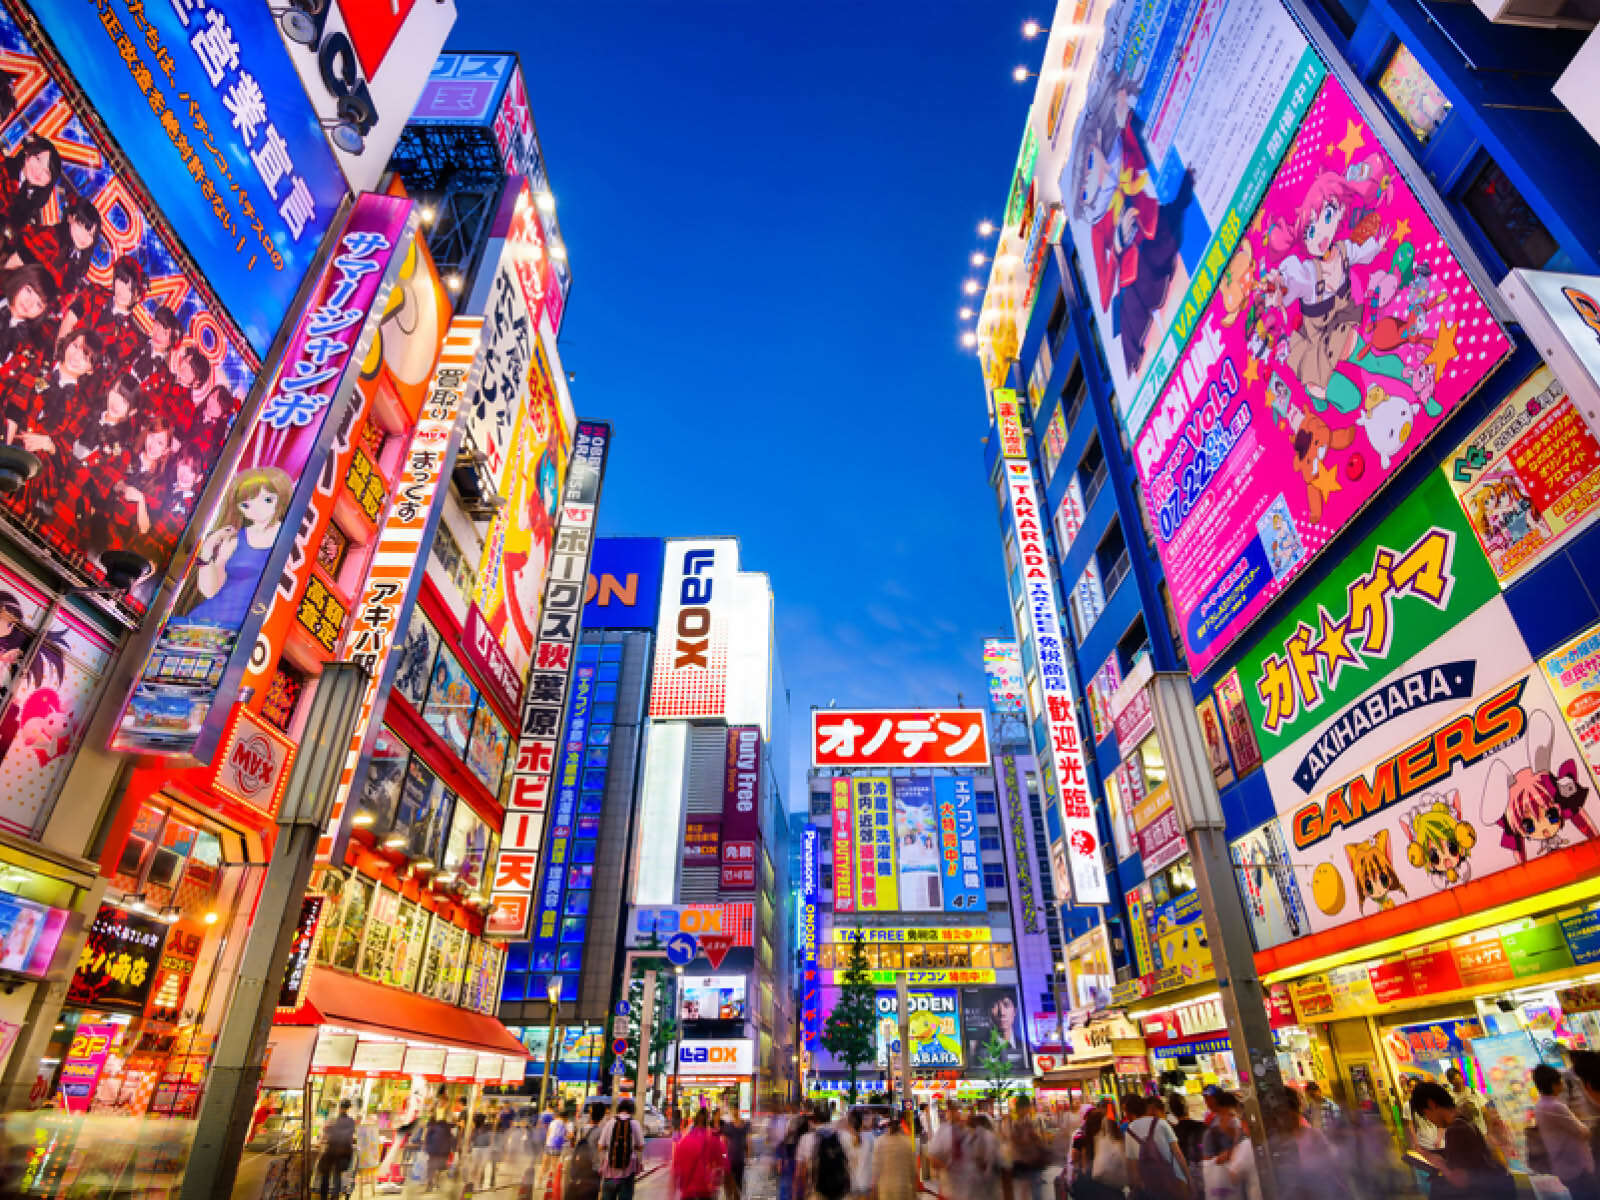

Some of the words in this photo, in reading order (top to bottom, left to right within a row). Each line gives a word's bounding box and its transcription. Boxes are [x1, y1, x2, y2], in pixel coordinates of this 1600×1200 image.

[262, 231, 390, 428] サマージャンボ
[1012, 485, 1046, 578] TAKARADA
[818, 713, 981, 758] オノデン
[1292, 675, 1529, 850] GAMERS
[1308, 668, 1452, 776] AKIHABARA
[870, 929, 904, 941] FREE
[69, 1036, 106, 1057] 2F
